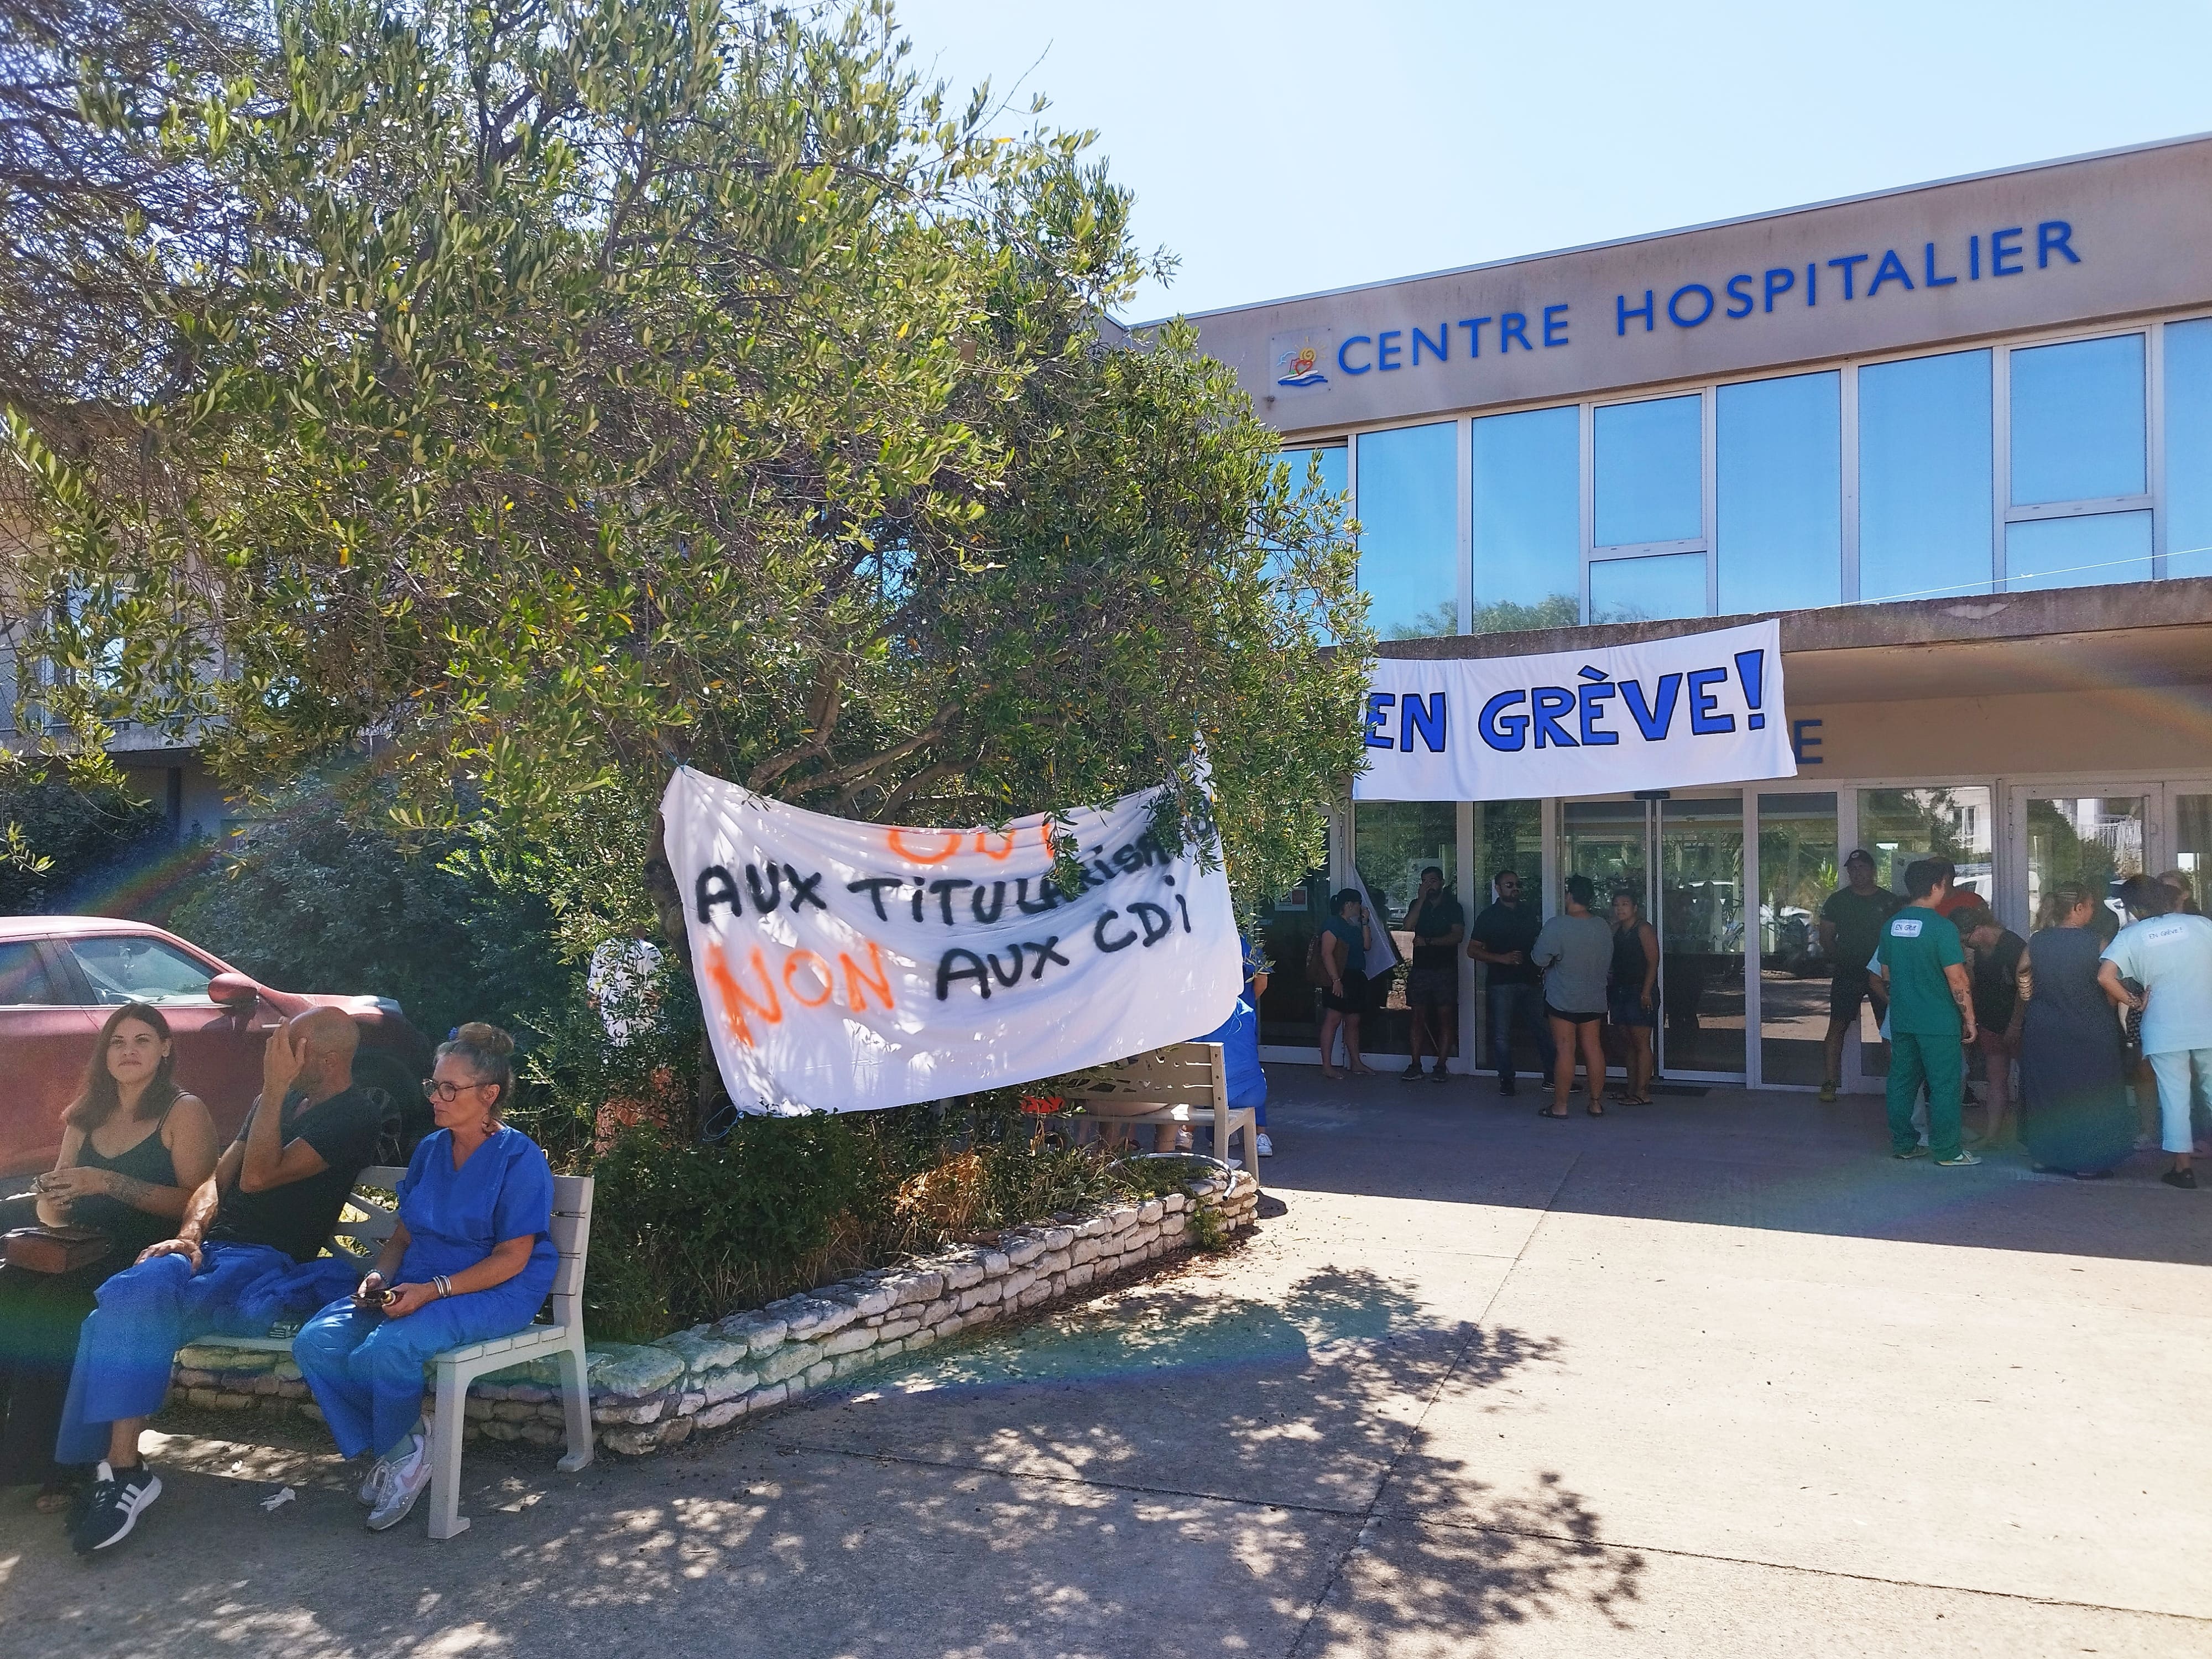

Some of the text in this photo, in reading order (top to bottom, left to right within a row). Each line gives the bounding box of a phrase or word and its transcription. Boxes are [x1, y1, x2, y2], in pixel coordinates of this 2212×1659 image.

[1337, 220, 2081, 375] CENTRE HOSPITALIER
[1364, 691, 1446, 753] EN
[696, 862, 827, 925] AUX
[705, 940, 895, 1048] NON
[936, 935, 1070, 1001] AUX
